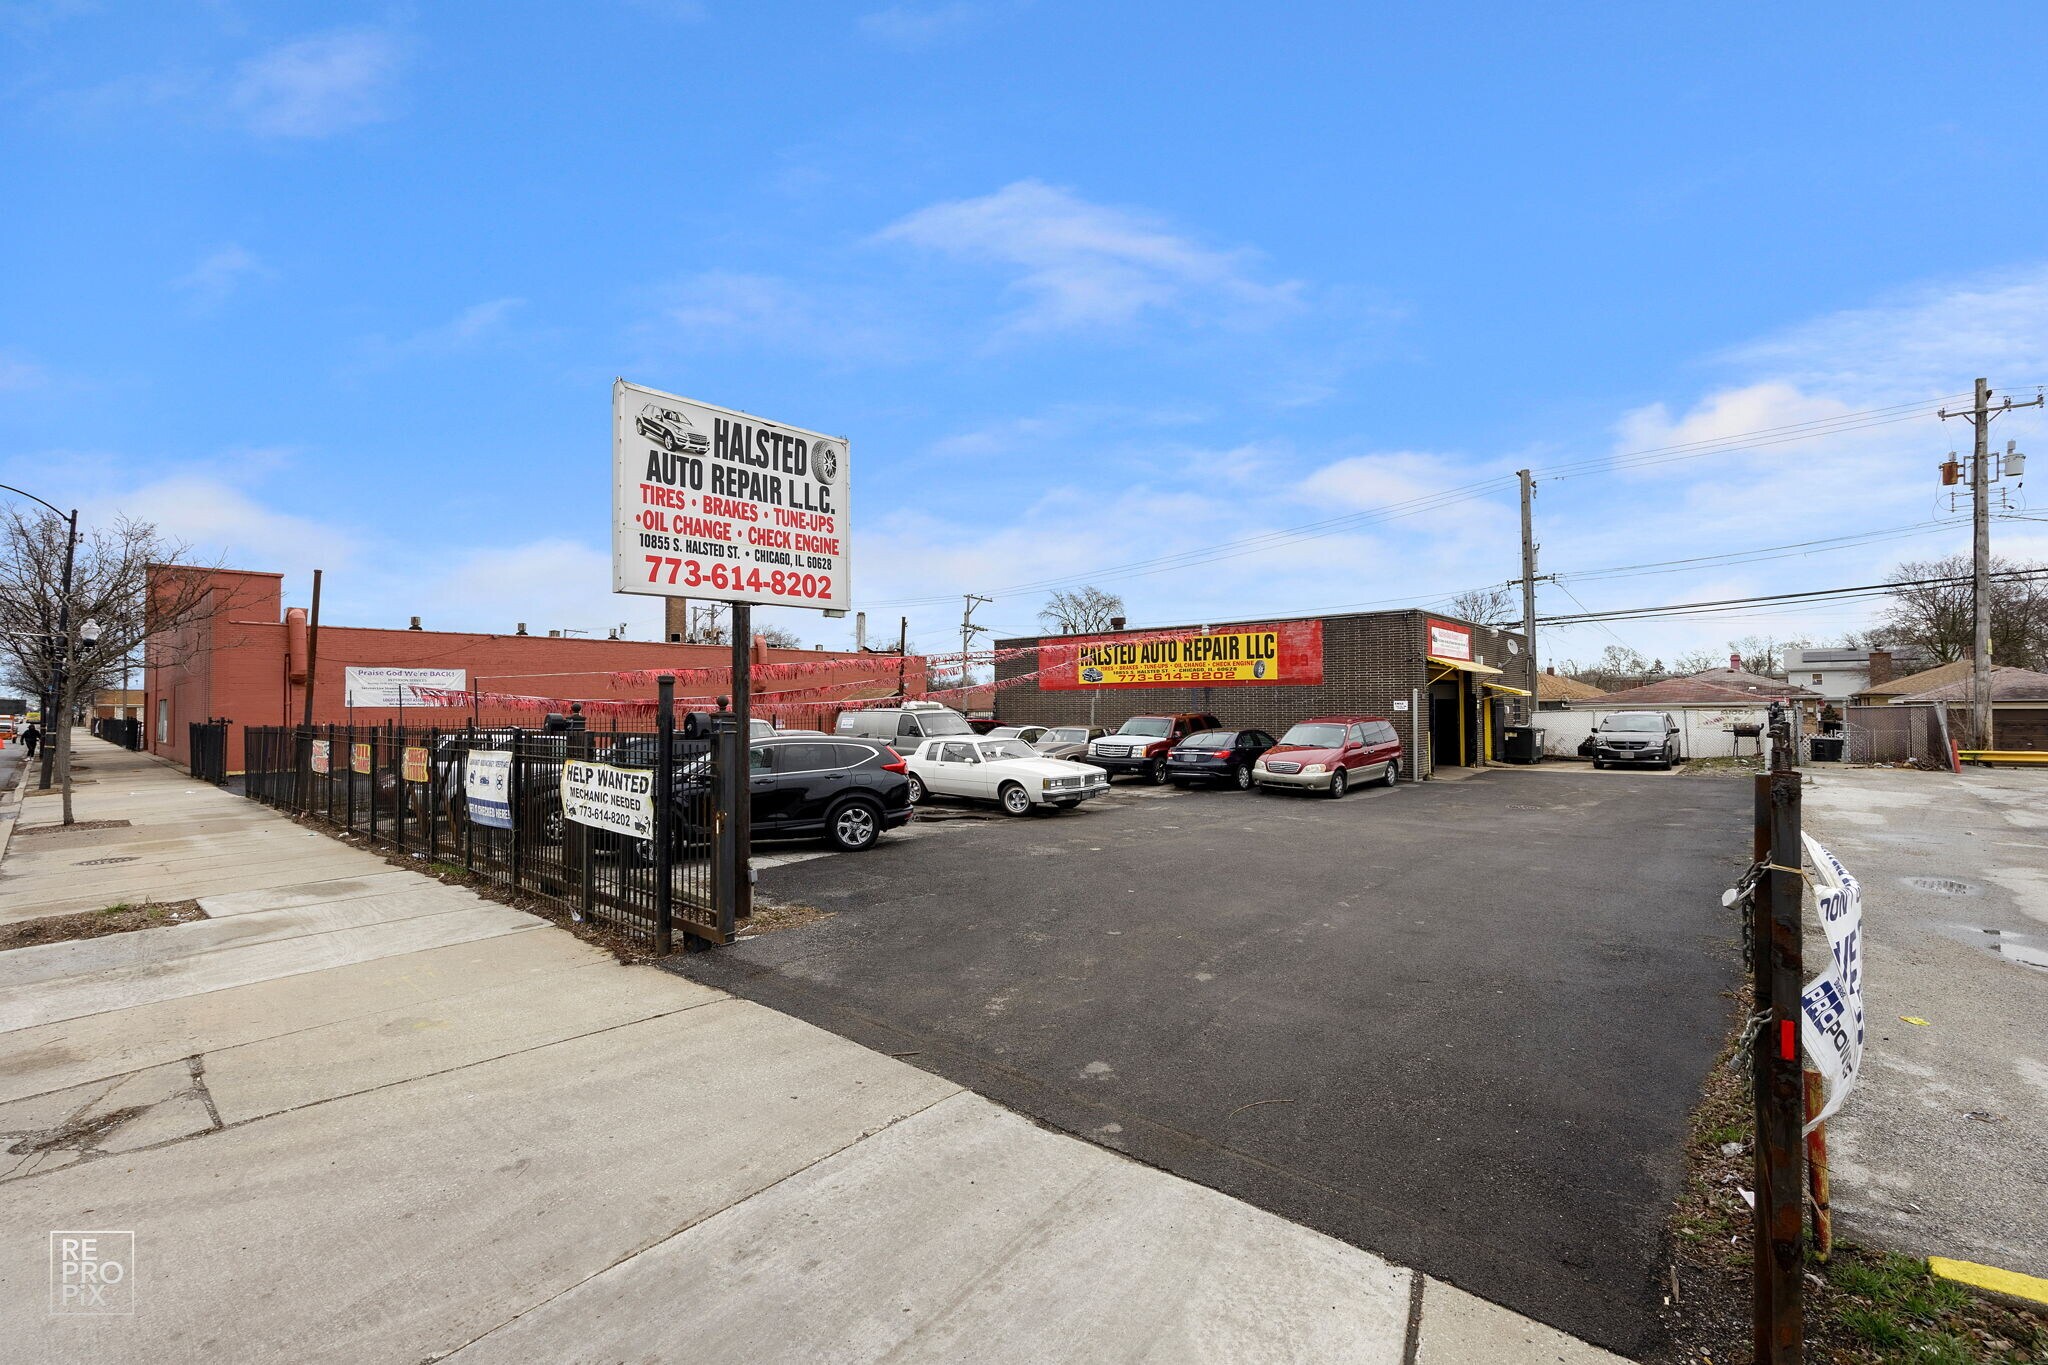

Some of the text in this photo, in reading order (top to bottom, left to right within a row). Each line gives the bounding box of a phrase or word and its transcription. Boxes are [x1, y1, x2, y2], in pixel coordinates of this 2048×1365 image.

[714, 417, 808, 477] HALSTED
[646, 449, 836, 515] AUTO REPAIR L.L.C.
[639, 483, 835, 534] TIRES BRAKES TUNE-UPS
[642, 509, 840, 556] OIL CHANGE CHECK ENGINE
[639, 533, 670, 551] 10855
[673, 538, 682, 552] S.
[685, 540, 725, 558] HALSTED
[727, 546, 740, 560] ST.
[754, 549, 793, 568] CHICAGO,
[807, 557, 832, 571] 60628
[645, 554, 832, 600] 773-614-8202
[1080, 633, 1275, 667] HALSTED AUTO REPAIR LLC
[1118, 672, 1236, 682] 773-614-8202
[567, 765, 650, 794] HELP WANTED
[570, 786, 641, 811] MECHANIC NEEDED
[579, 805, 631, 827] 773-614-8202
